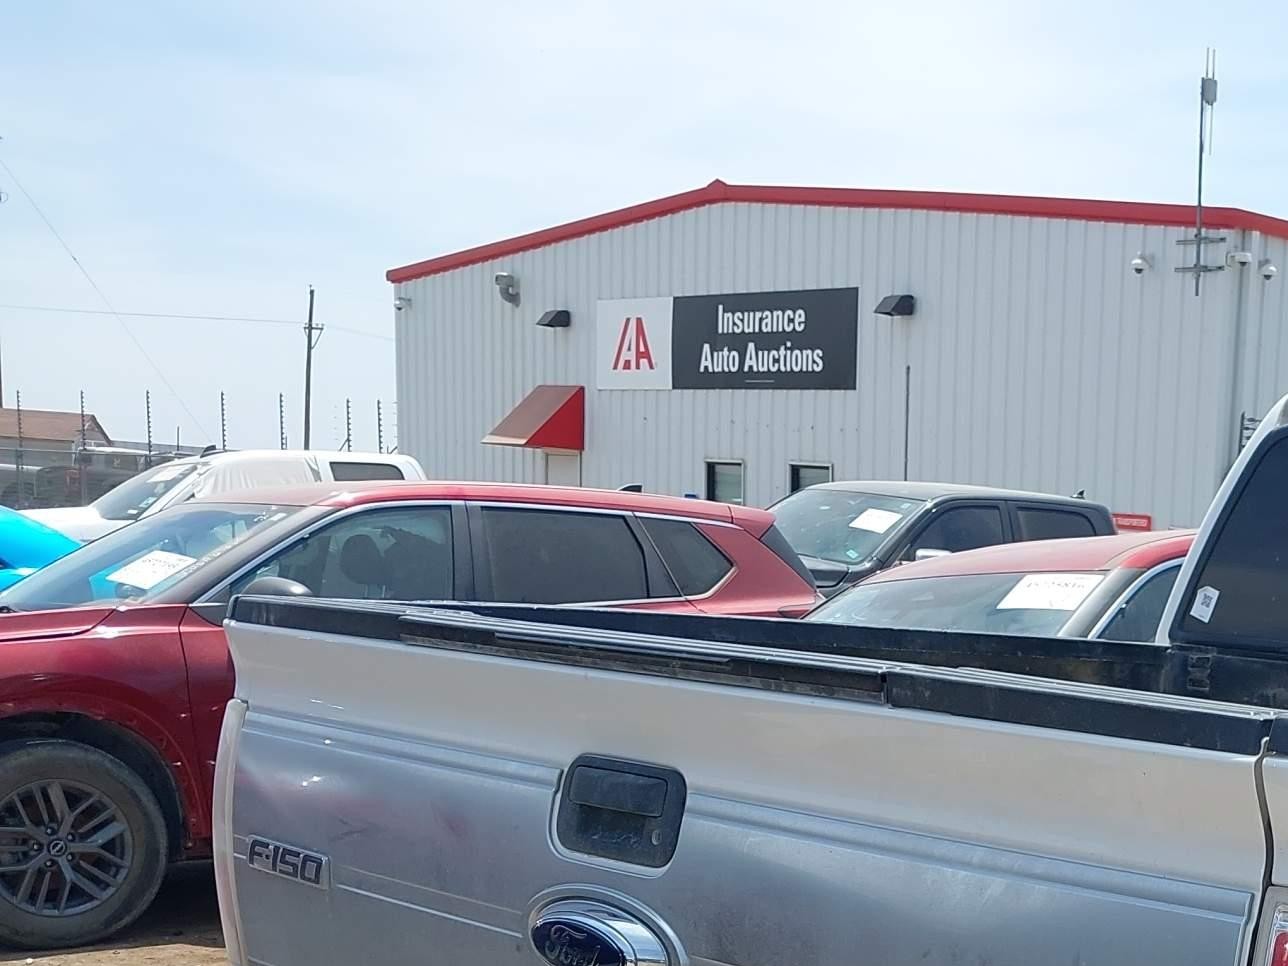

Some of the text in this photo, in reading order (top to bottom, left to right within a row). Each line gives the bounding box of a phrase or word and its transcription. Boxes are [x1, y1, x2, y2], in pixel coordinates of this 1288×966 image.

[718, 304, 806, 334] Insurance
[699, 341, 824, 372] Auto Auctions
